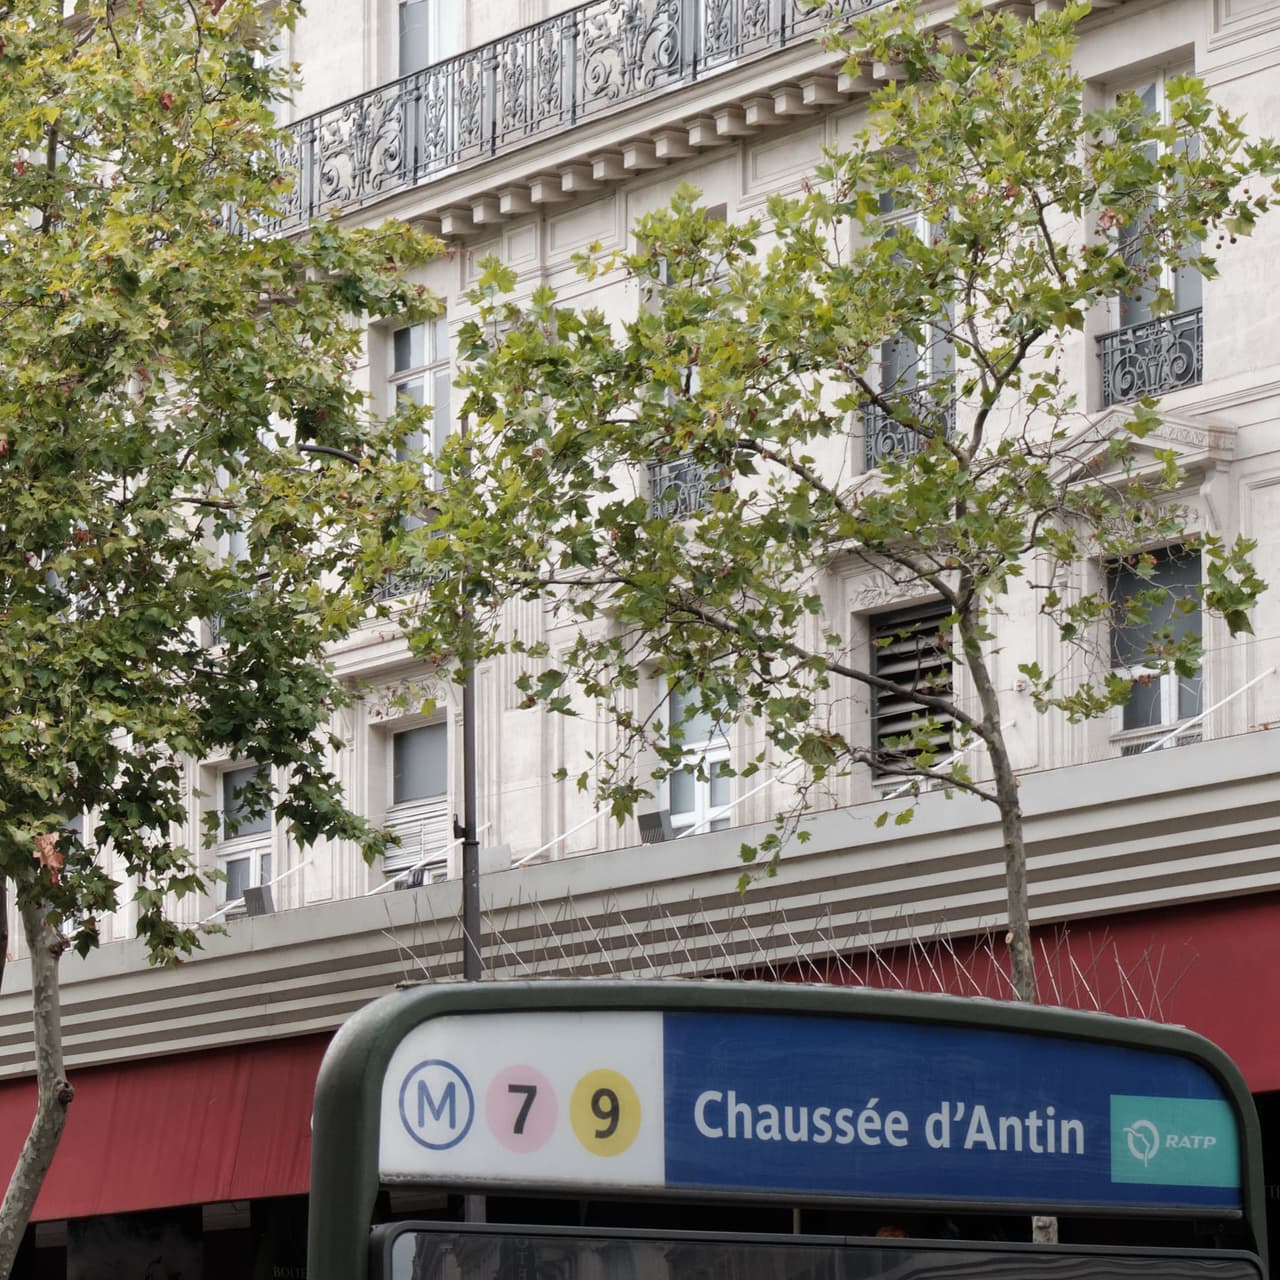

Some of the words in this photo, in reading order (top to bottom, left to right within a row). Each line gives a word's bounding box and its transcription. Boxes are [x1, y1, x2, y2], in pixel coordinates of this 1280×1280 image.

[415, 1080, 458, 1130] M
[507, 1083, 538, 1134] 7
[591, 1088, 620, 1139] 9
[693, 1090, 909, 1149] Chaussée
[925, 1101, 1086, 1155] d’Antin
[1165, 1134, 1217, 1151] RATP
